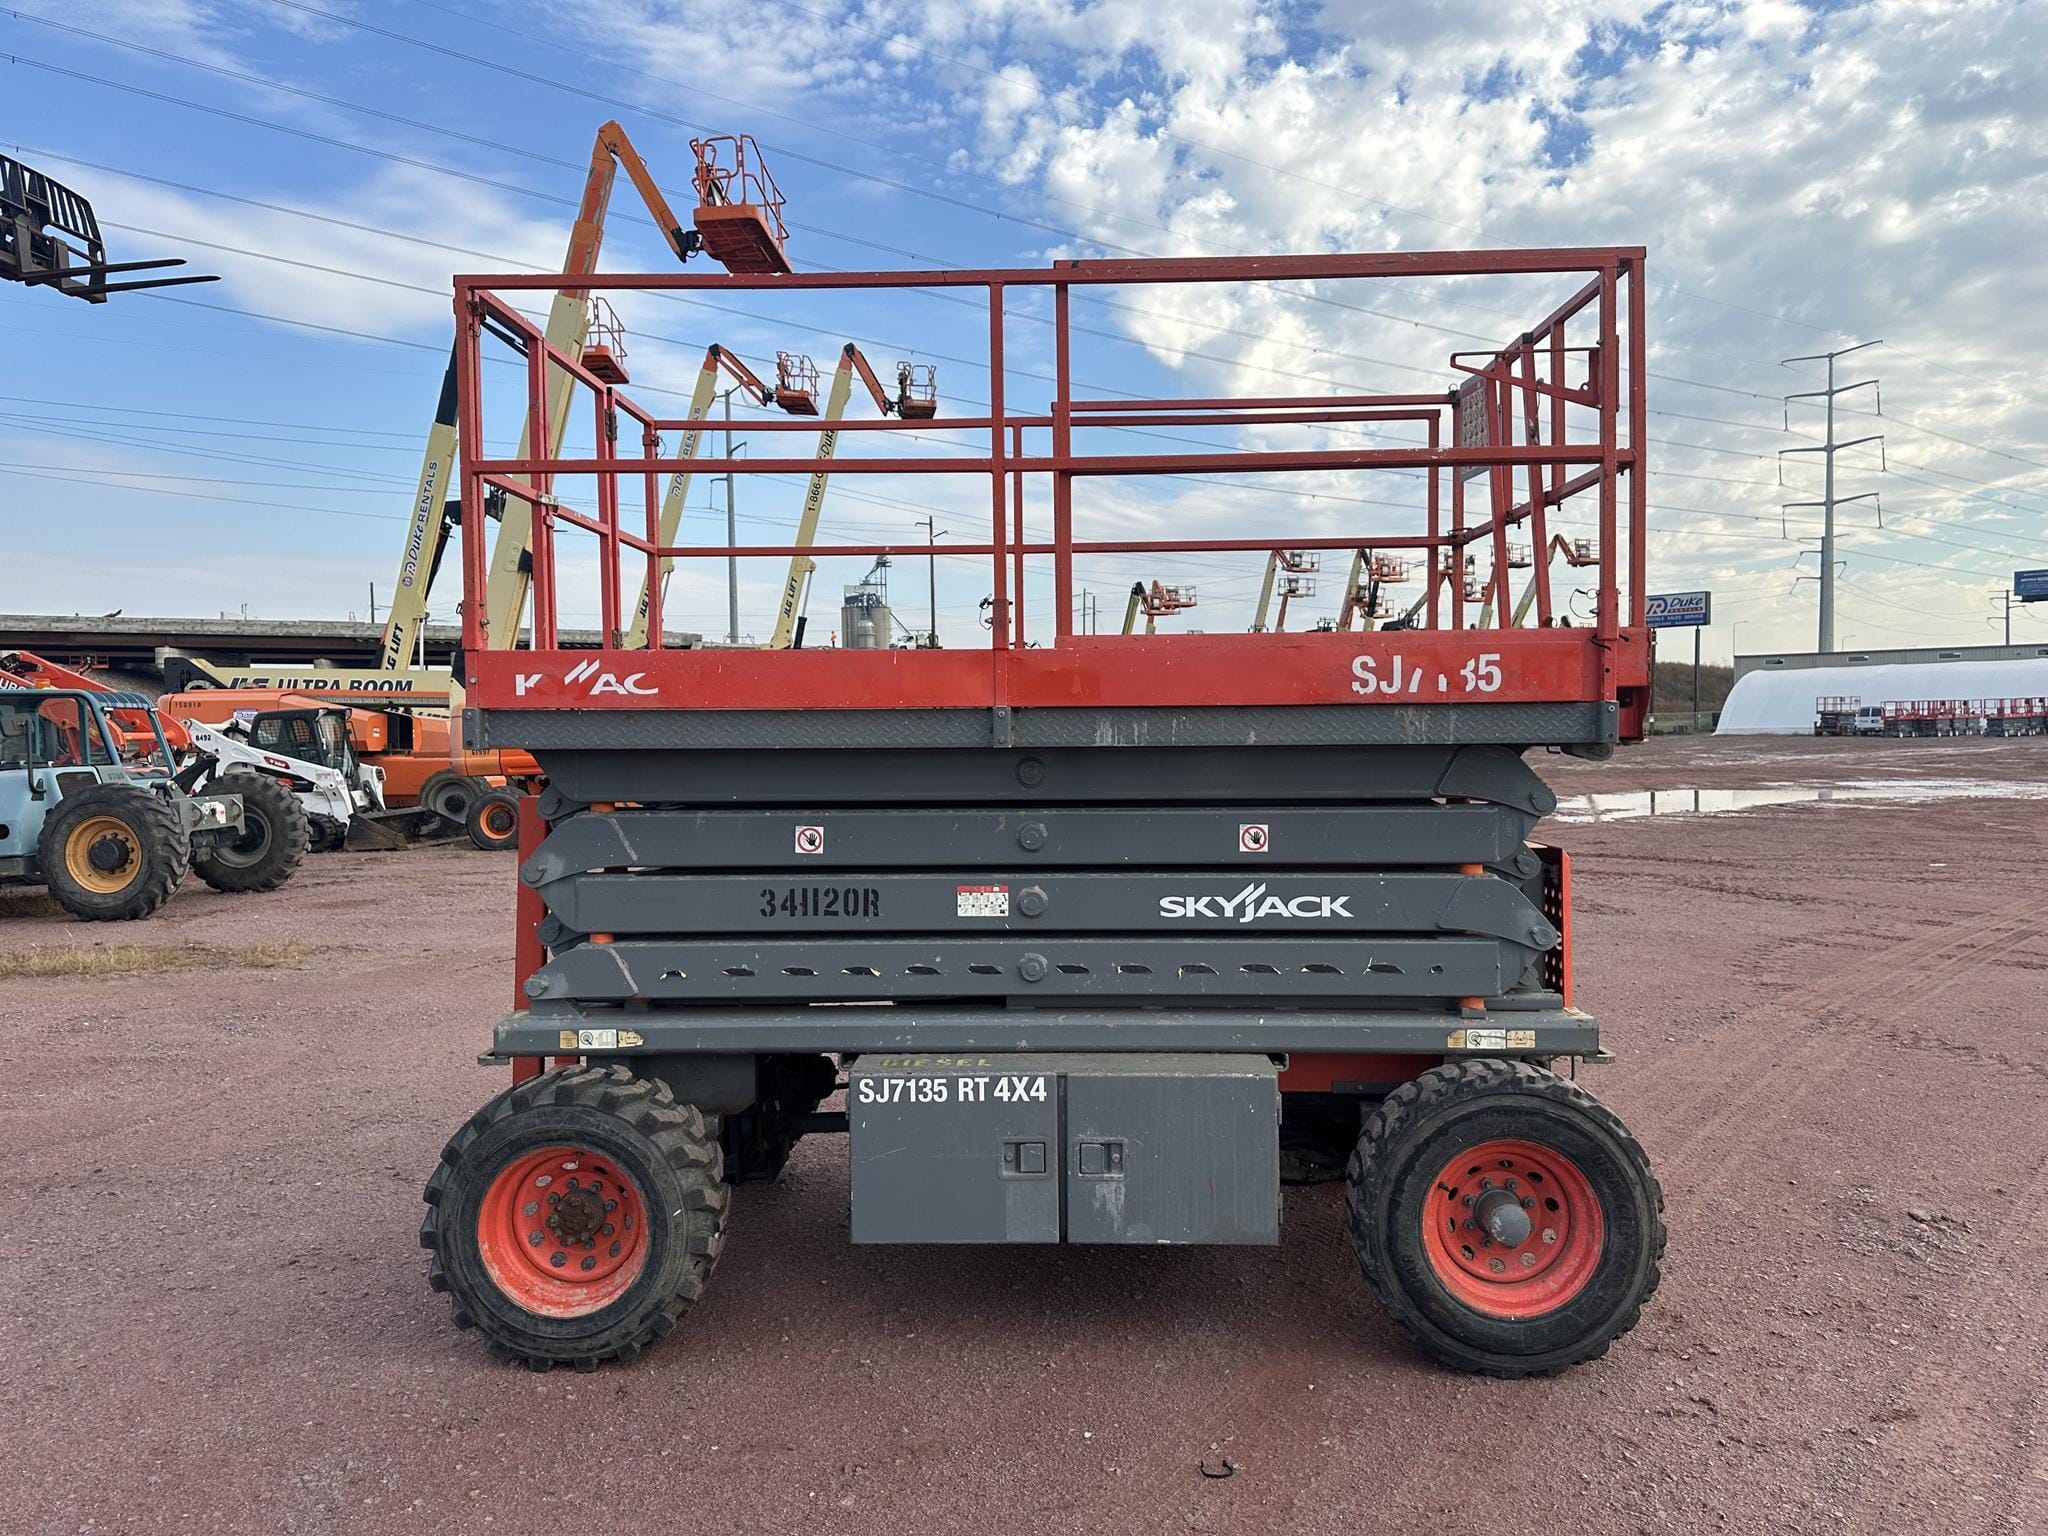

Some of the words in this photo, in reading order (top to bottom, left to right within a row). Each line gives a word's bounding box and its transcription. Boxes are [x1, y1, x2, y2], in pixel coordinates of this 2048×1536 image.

[418, 461, 438, 523] RENTALS
[788, 576, 798, 599] LIFT
[784, 599, 793, 618] JLG
[390, 622, 404, 655] LIFT
[1159, 881, 1355, 923] SKYJACK
[881, 1058, 993, 1068] DIESEL
[858, 1077, 948, 1103] SJ7135
[957, 1076, 990, 1102] RT
[993, 1076, 1047, 1102] 4X4
